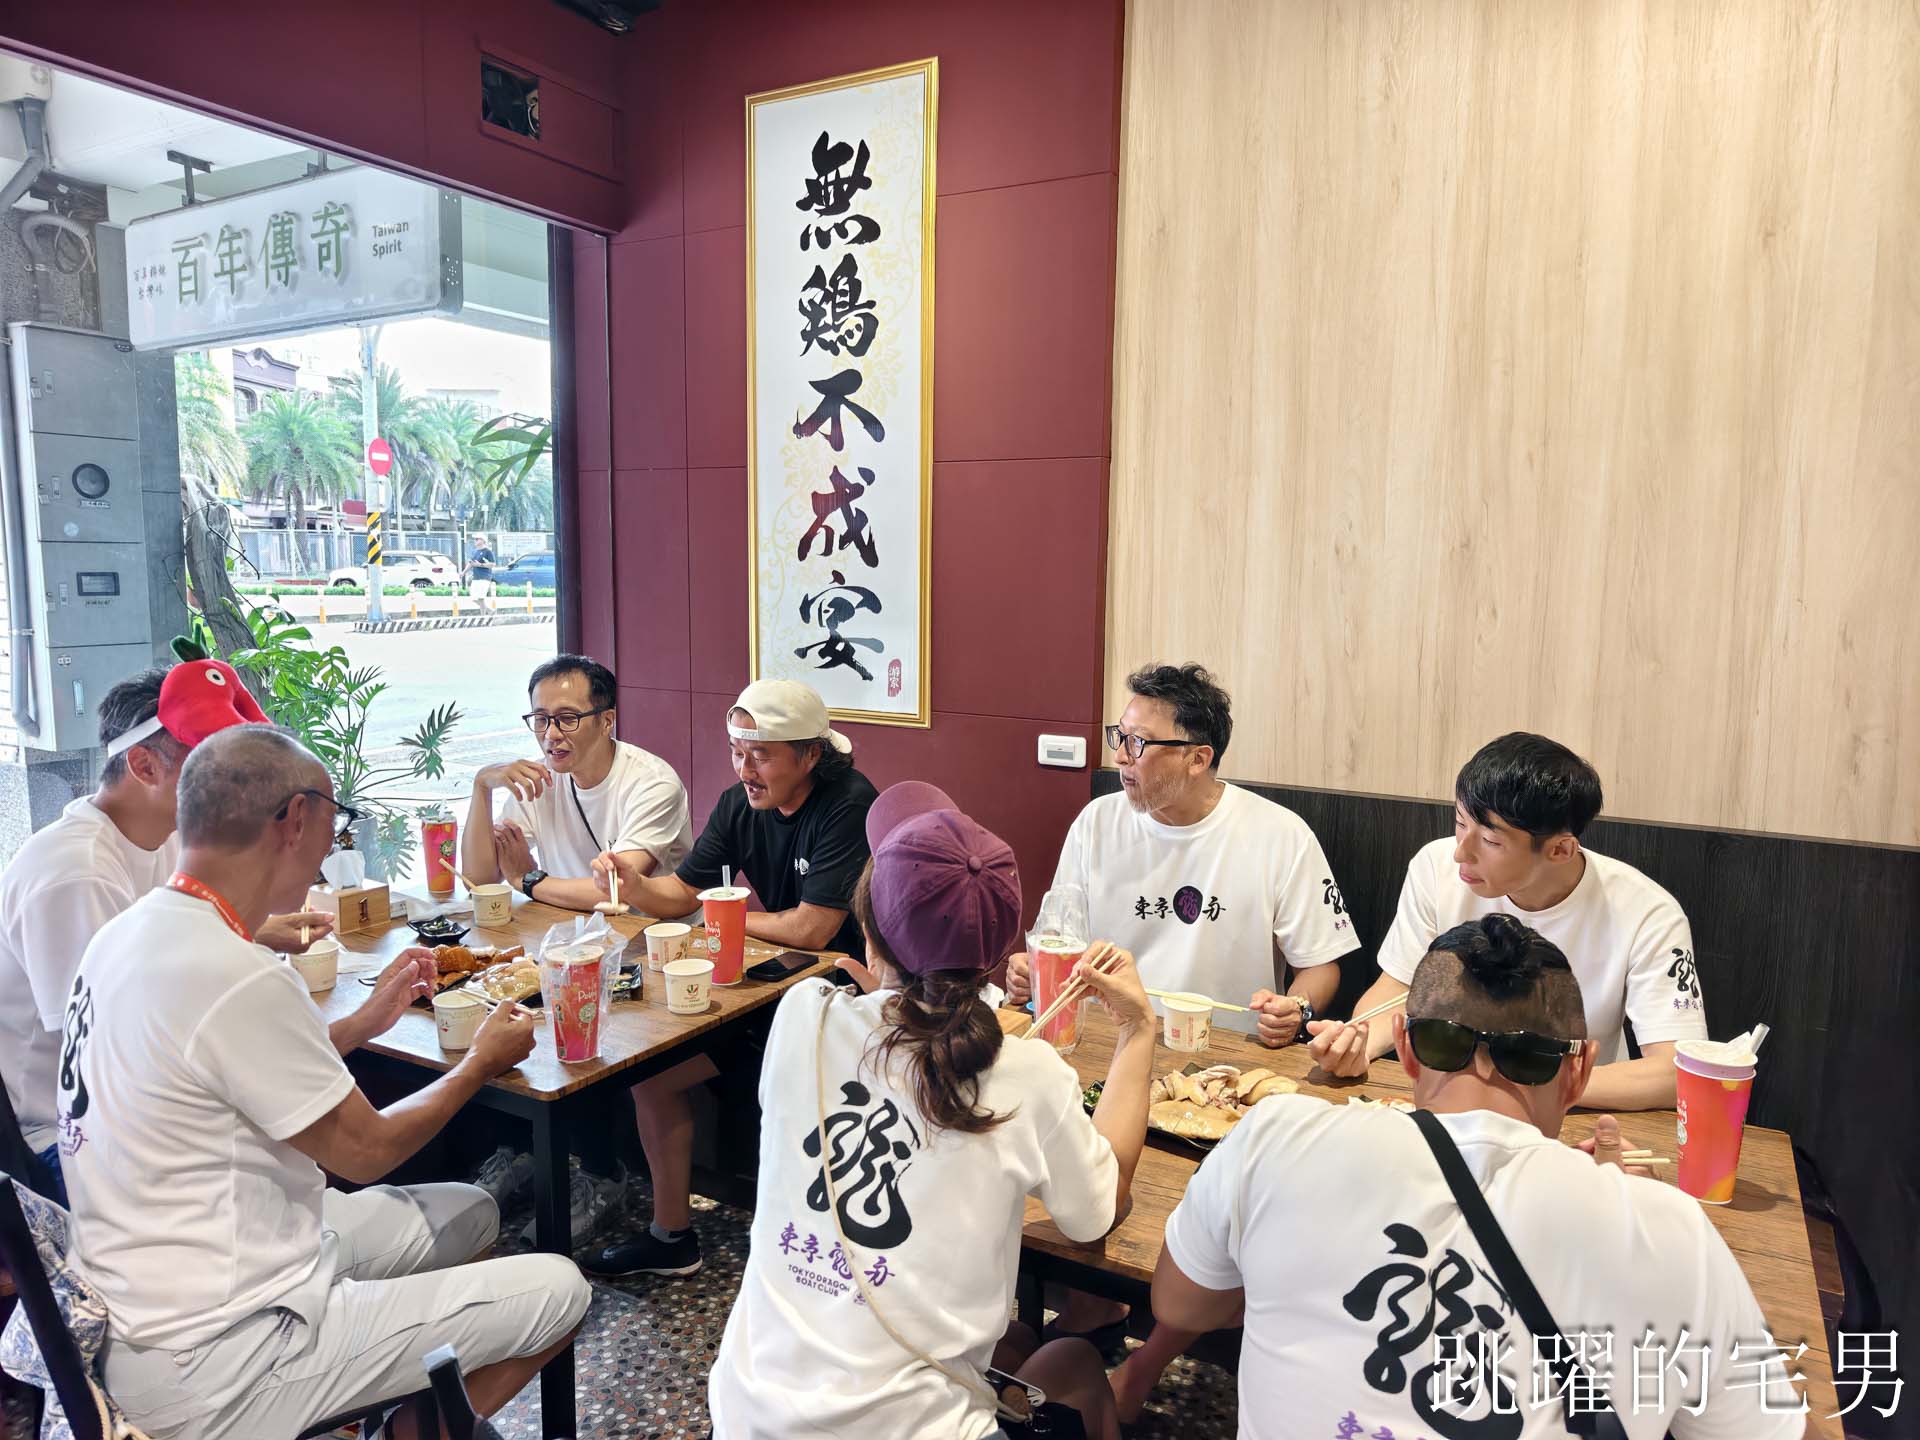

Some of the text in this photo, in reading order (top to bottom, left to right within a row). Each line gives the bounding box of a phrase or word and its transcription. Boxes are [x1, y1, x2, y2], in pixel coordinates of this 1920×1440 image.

[373, 221, 409, 237] Taiwan
[171, 205, 349, 305] 百年傳奇
[373, 239, 402, 259] Spirit
[788, 1264, 816, 1280] TOKYO
[796, 1276, 839, 1297] BOAT CLUB
